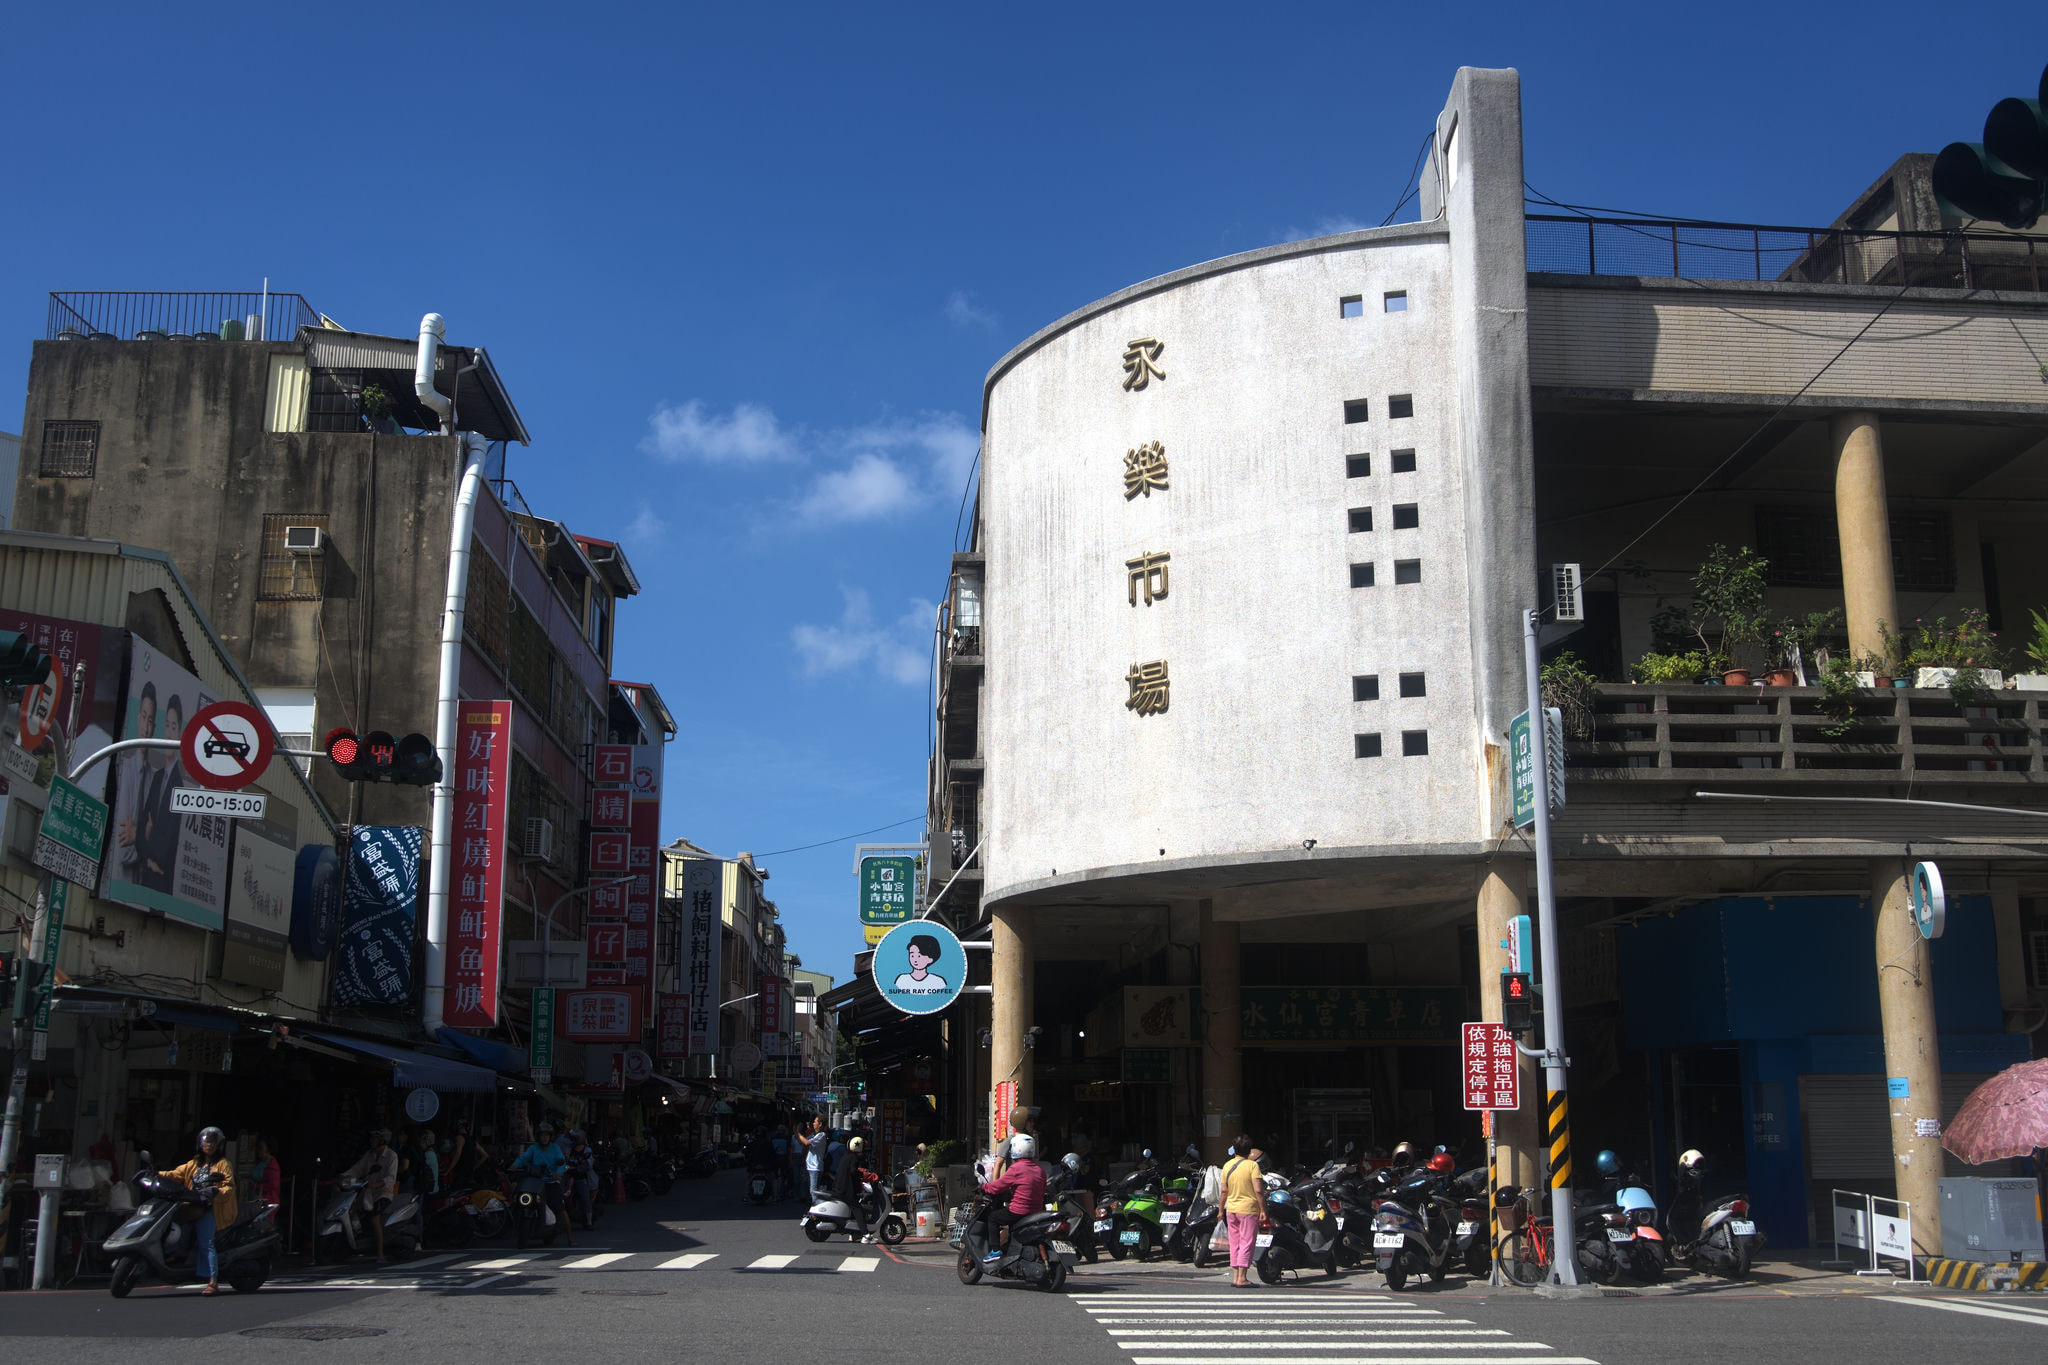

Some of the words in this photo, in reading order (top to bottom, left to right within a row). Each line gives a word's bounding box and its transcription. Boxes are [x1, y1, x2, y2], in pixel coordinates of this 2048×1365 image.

[1122, 336, 1170, 717] 永樂市場
[176, 794, 262, 813] 10:00-15:00
[361, 841, 401, 898] 富盛號
[362, 940, 402, 998] 富盛號
[1241, 999, 1441, 1027] 水仙宮青草店
[1468, 1026, 1489, 1106] 依規定停車
[1492, 1026, 1514, 1106] 加強拖吊區
